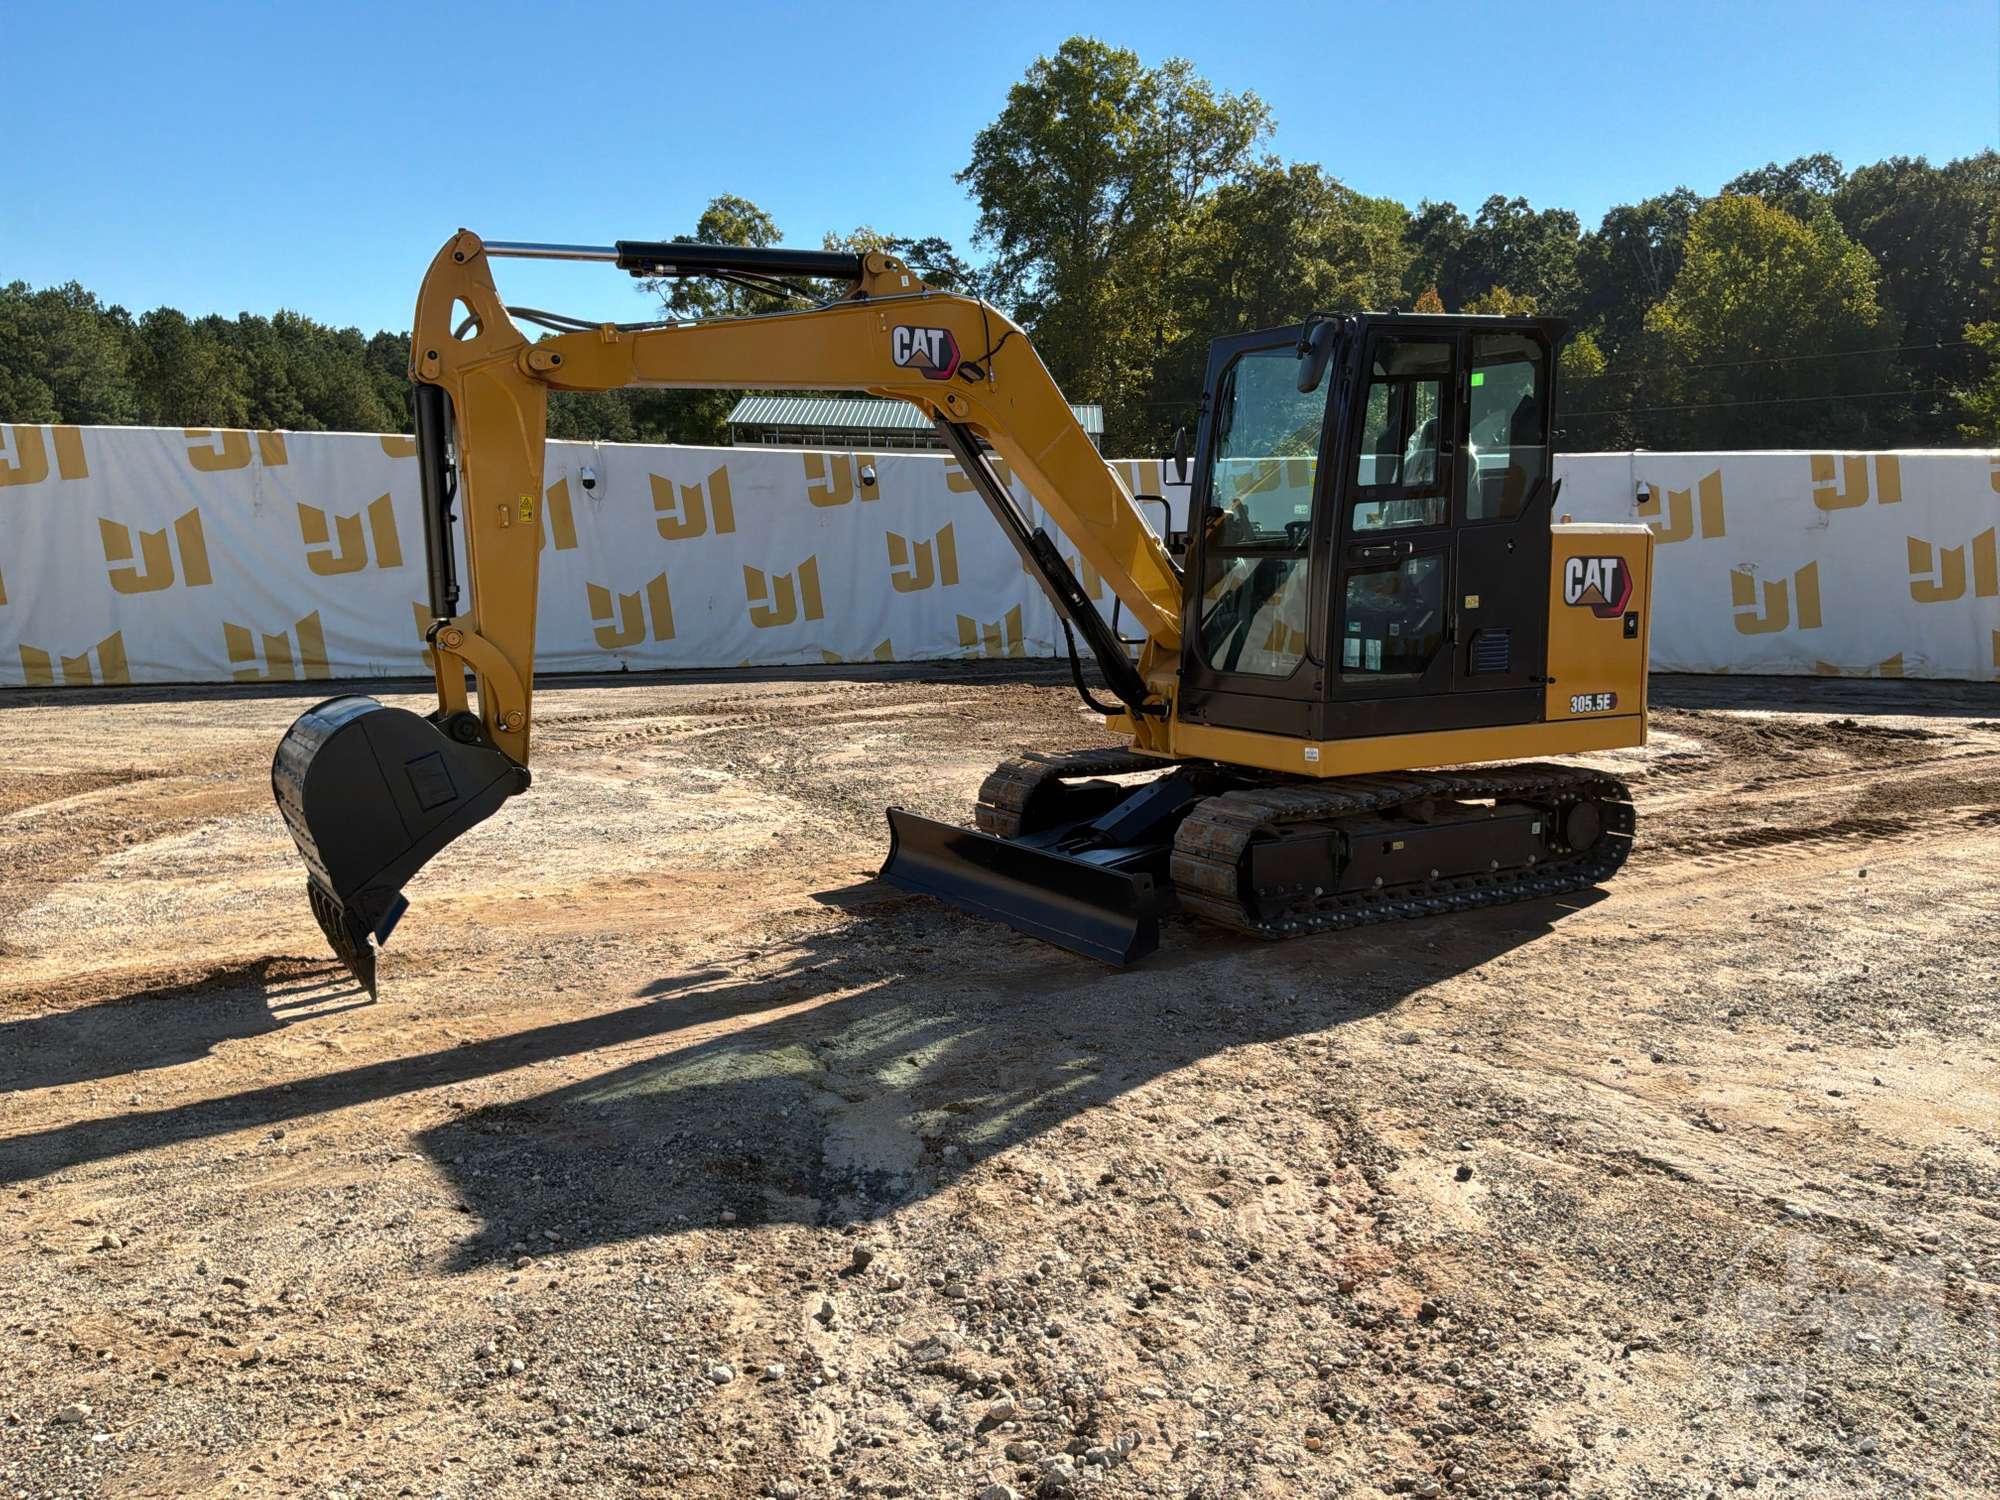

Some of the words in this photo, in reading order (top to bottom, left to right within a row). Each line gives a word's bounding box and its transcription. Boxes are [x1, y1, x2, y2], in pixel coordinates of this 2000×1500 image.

[893, 326, 944, 369] CAT
[1566, 558, 1618, 604] CAT
[1570, 693, 1611, 713] 305.5E
